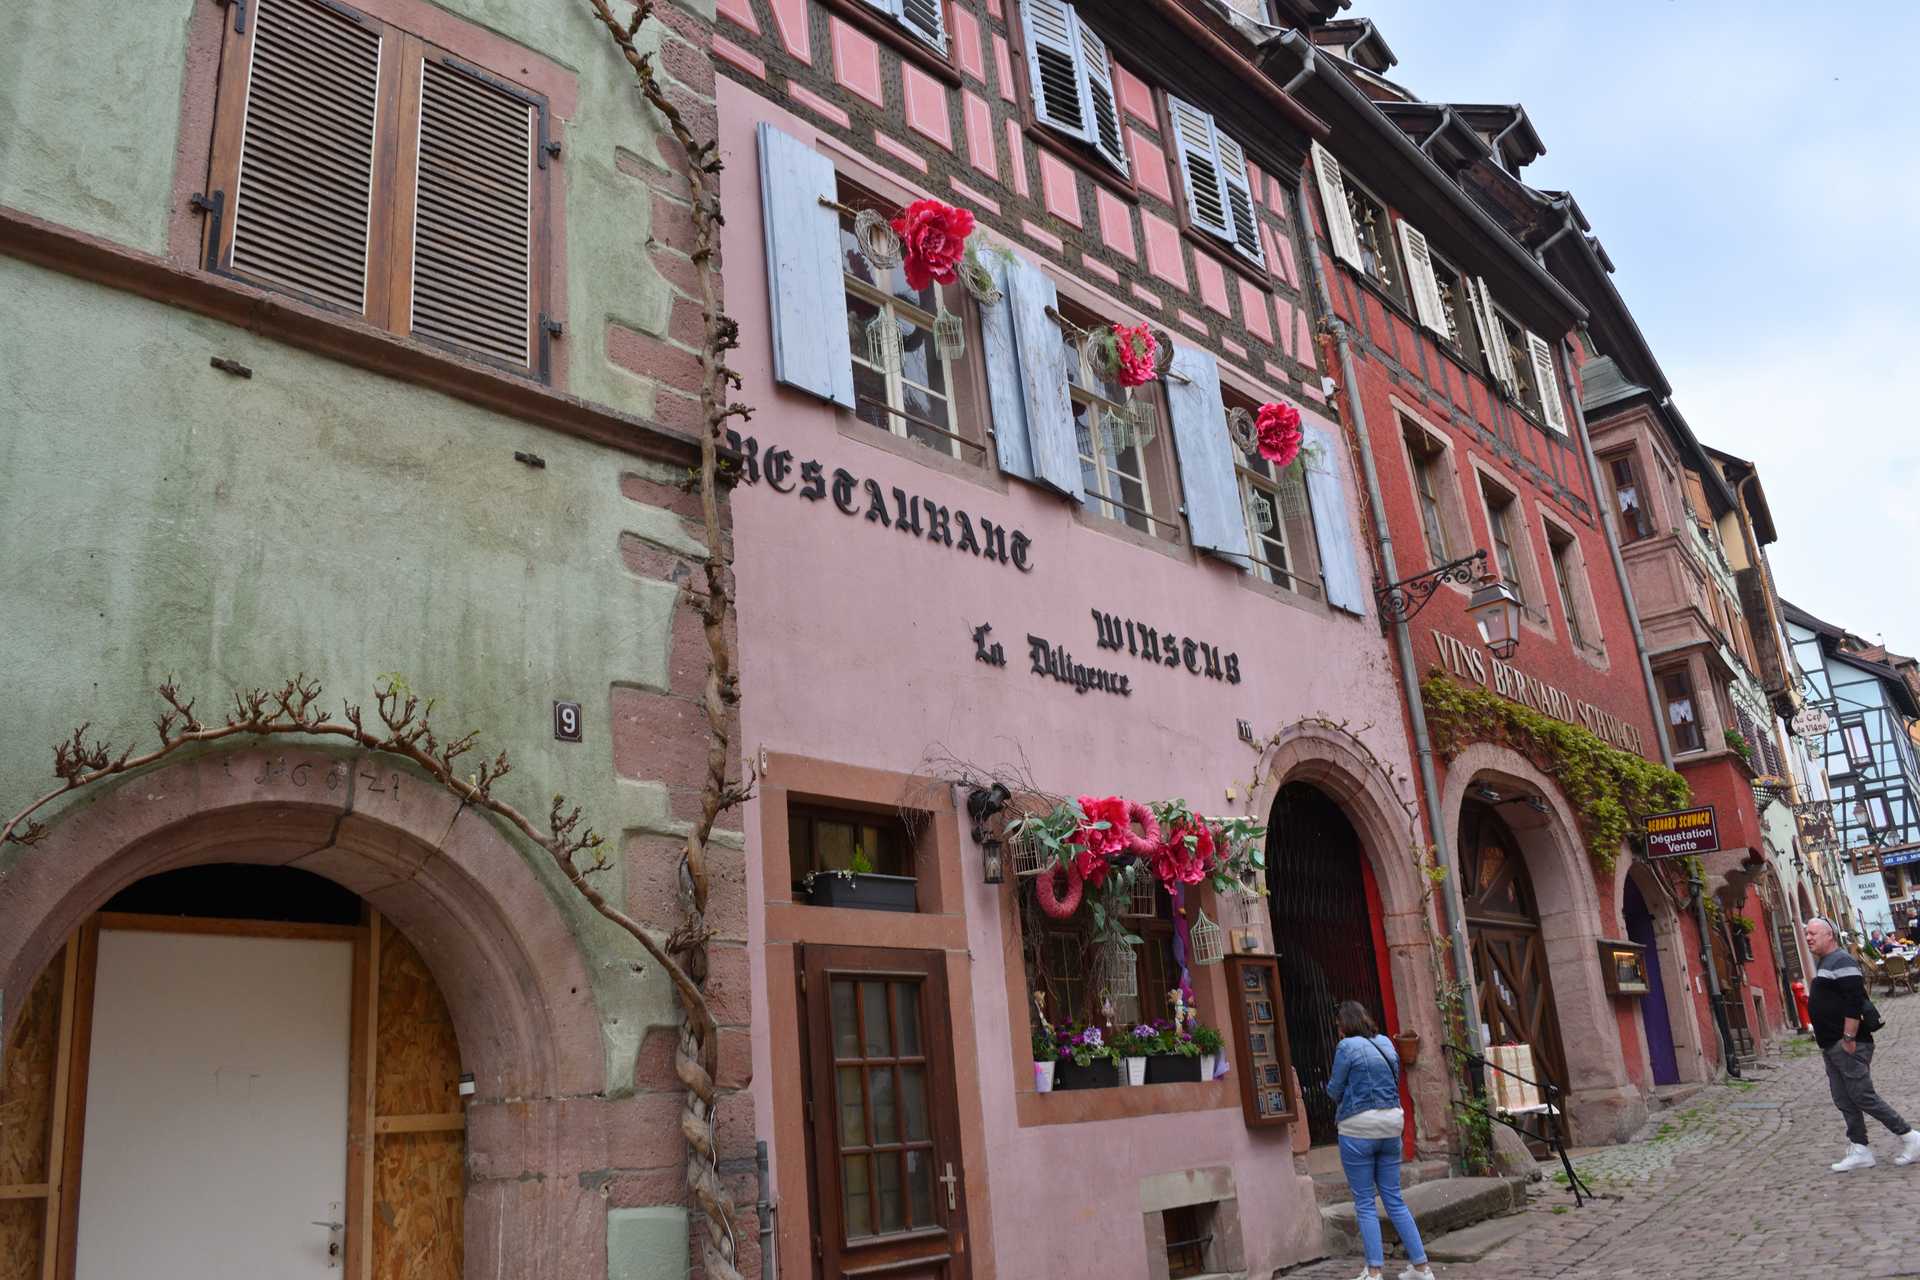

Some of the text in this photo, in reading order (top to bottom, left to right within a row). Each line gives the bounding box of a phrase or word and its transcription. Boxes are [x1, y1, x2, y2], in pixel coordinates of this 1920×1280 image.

[973, 621, 1008, 669] La
[1091, 608, 1241, 685] WINSTUB
[1430, 628, 1645, 757] VINS BERNARD SCHWACH
[562, 708, 576, 733] 9
[1648, 811, 1710, 832] BERNARD SCHWACH
[1650, 828, 1712, 845] Dégustation
[1668, 841, 1697, 852] Vente
